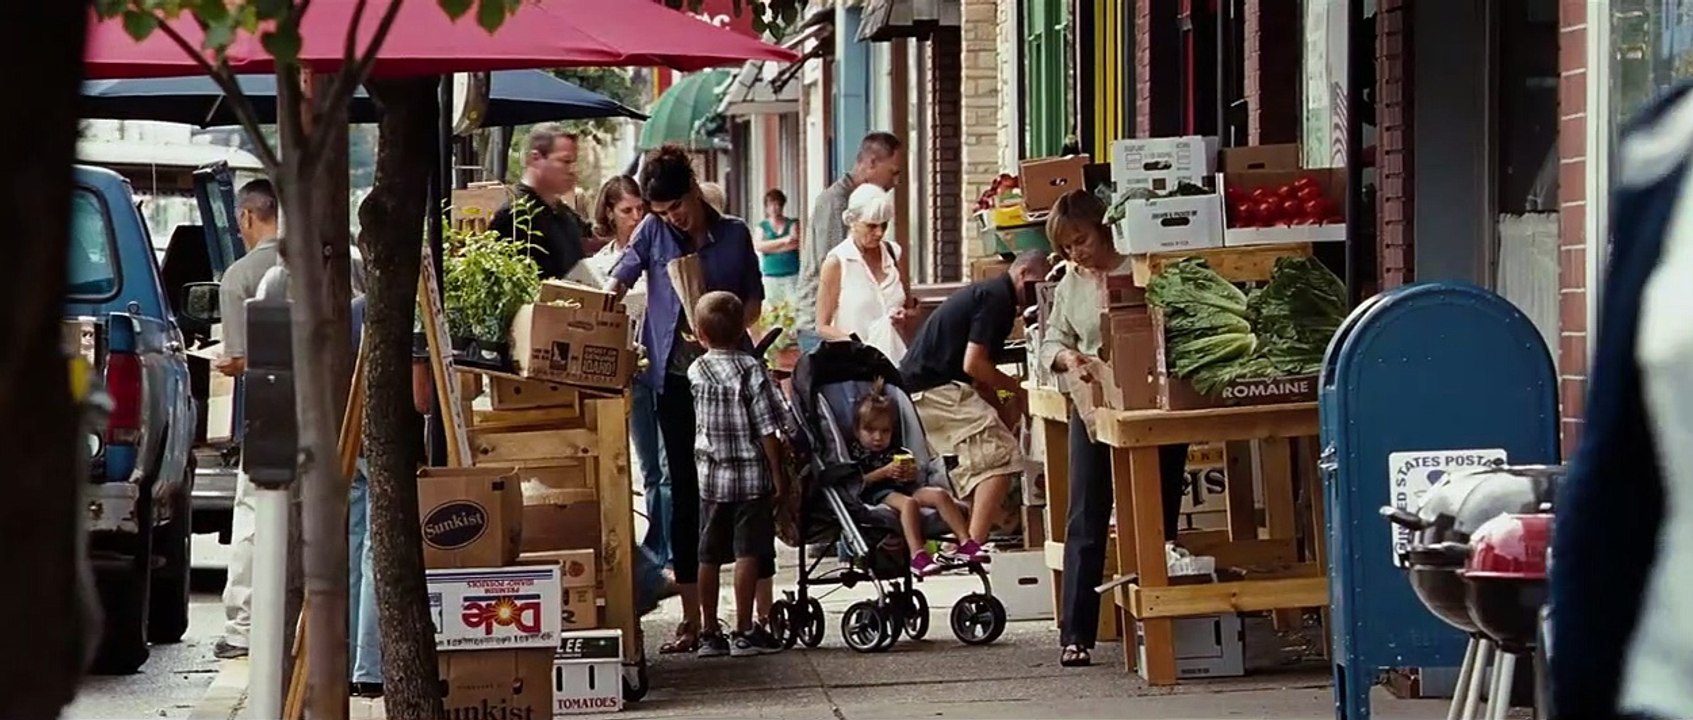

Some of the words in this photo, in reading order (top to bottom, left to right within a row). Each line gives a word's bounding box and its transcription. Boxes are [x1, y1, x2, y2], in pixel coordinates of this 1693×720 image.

[1222, 380, 1309, 399] ROMAINE
[1395, 456, 1440, 488] STATES
[1445, 454, 1494, 468] POSTA
[424, 510, 484, 539] Sunkist
[1396, 491, 1409, 551] UNED
[484, 587, 520, 595] PREMIUM
[461, 600, 541, 635] Dole
[557, 696, 617, 710] TOMATOES
